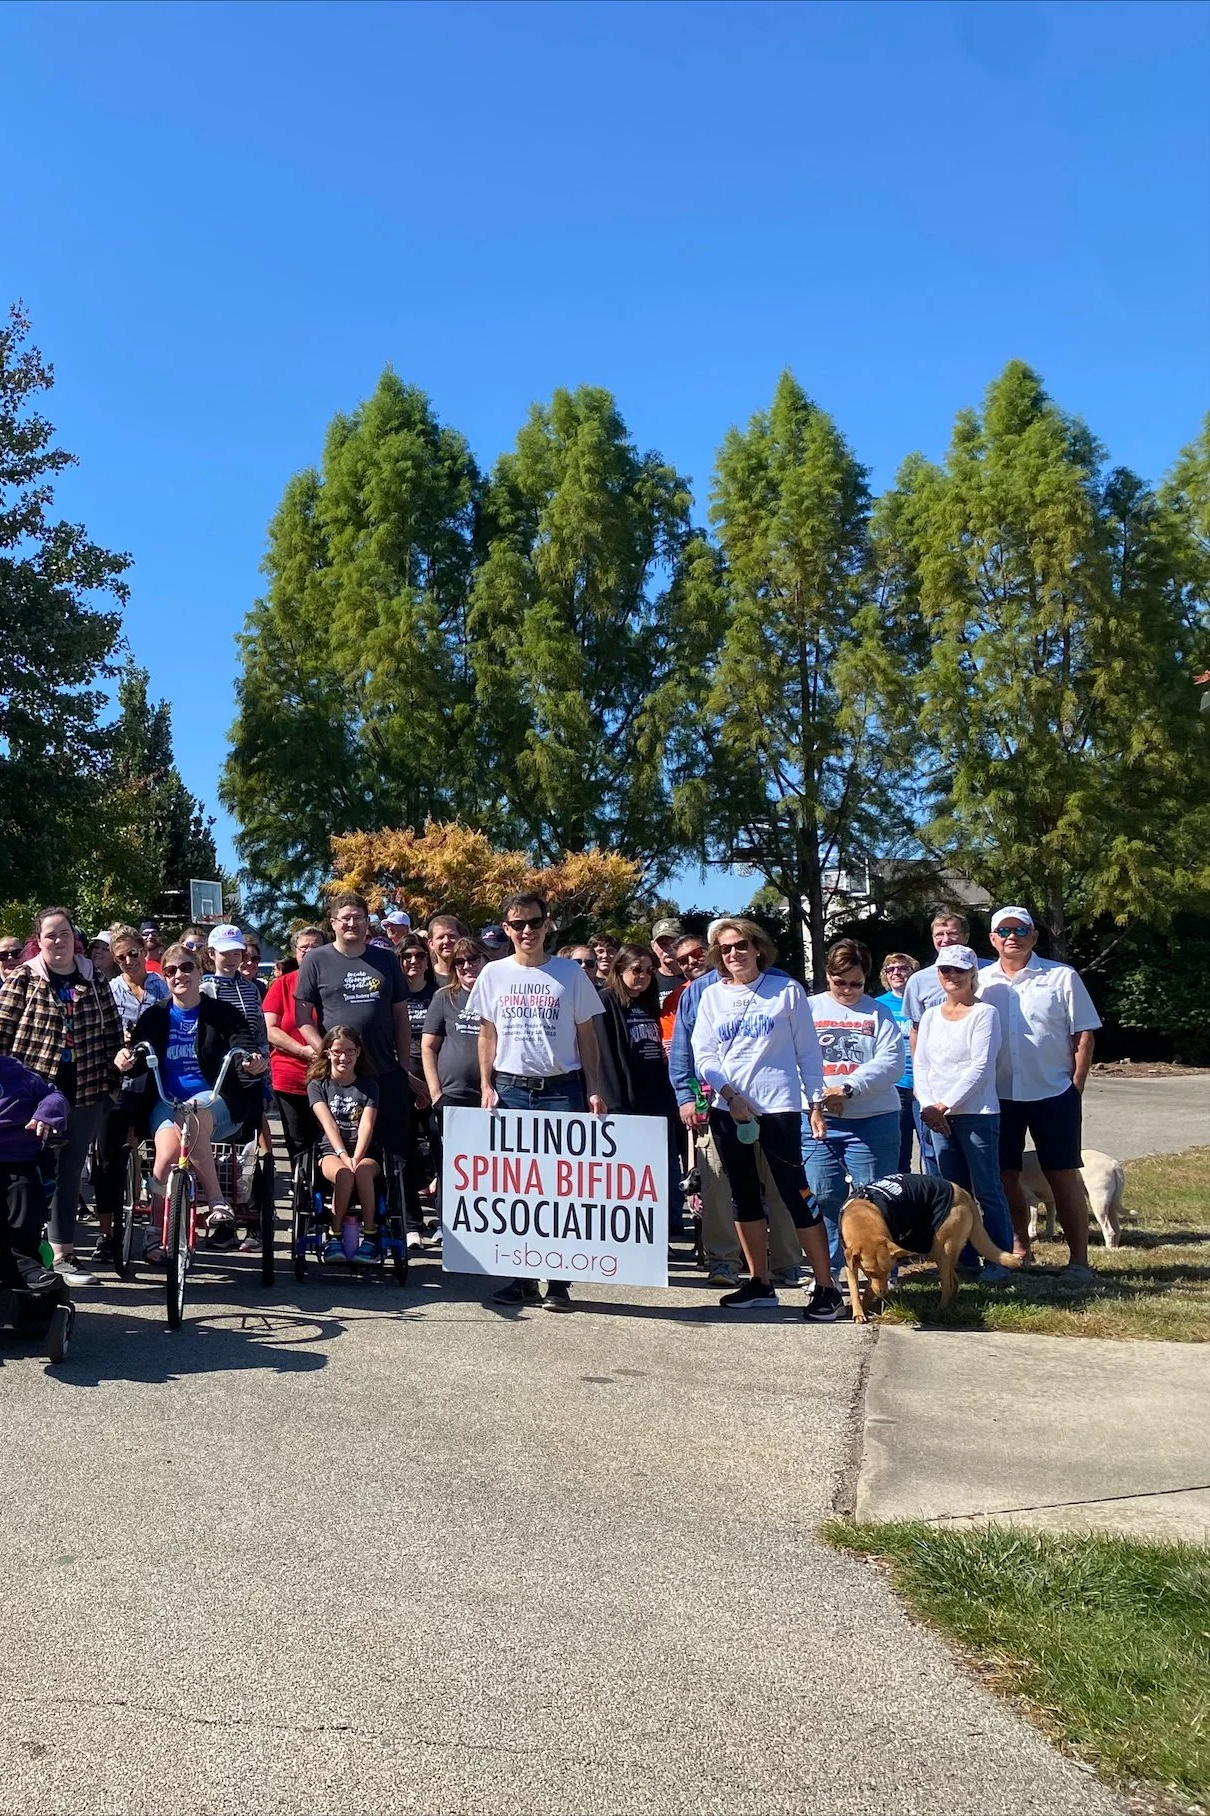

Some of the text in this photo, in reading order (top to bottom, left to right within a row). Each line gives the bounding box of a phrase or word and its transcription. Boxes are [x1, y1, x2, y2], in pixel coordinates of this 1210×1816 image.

[510, 983, 551, 995] ILLINOIS
[499, 995, 561, 1009] SPINA BIFIDA
[501, 1006, 560, 1020] ASSOCIATION
[733, 998, 758, 1008] ISBA
[489, 1116, 618, 1158] ILLINOIS
[453, 1154, 659, 1203] SPINA BIFIDA
[452, 1195, 654, 1245] ASSOCIATION
[494, 1242, 618, 1277] i-sba.org
